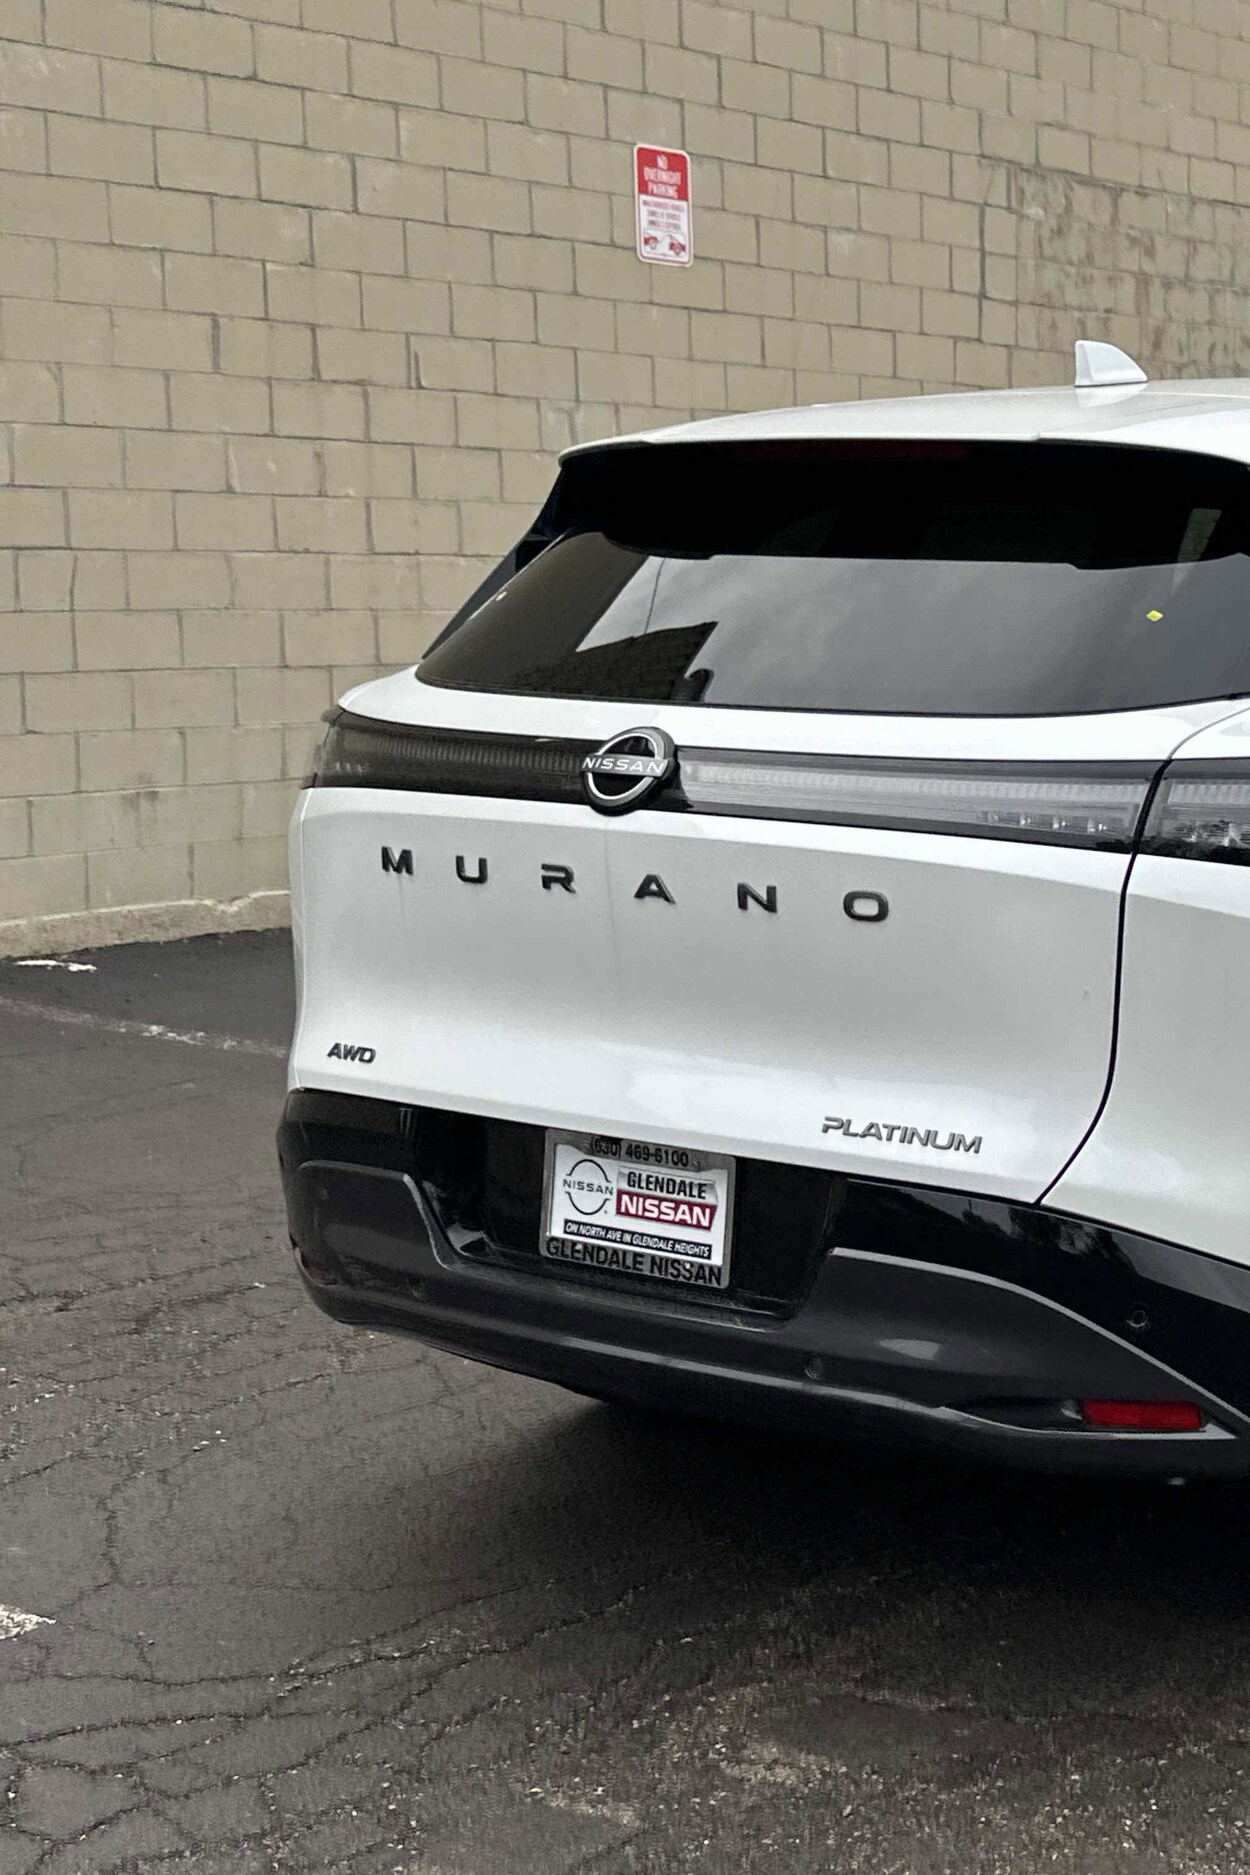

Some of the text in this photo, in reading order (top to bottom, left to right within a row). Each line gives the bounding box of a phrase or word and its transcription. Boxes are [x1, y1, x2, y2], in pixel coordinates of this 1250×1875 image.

[643, 166, 682, 186] OVERNIGHT
[647, 181, 679, 199] PARKING
[582, 756, 665, 774] NISSAN
[380, 845, 890, 923] MURANO
[327, 1042, 376, 1065] AWD
[821, 1115, 983, 1155] PLATINUM
[625, 1143, 689, 1167] 469-6100
[563, 1178, 614, 1197] NISSAN
[627, 1171, 708, 1200] GLENDALE
[620, 1194, 711, 1227] NISSAN
[565, 1222, 710, 1256] ON NORTH AVE IN GLENDALE HEIGHTS
[546, 1237, 722, 1286] GLENDALE NISSAN
